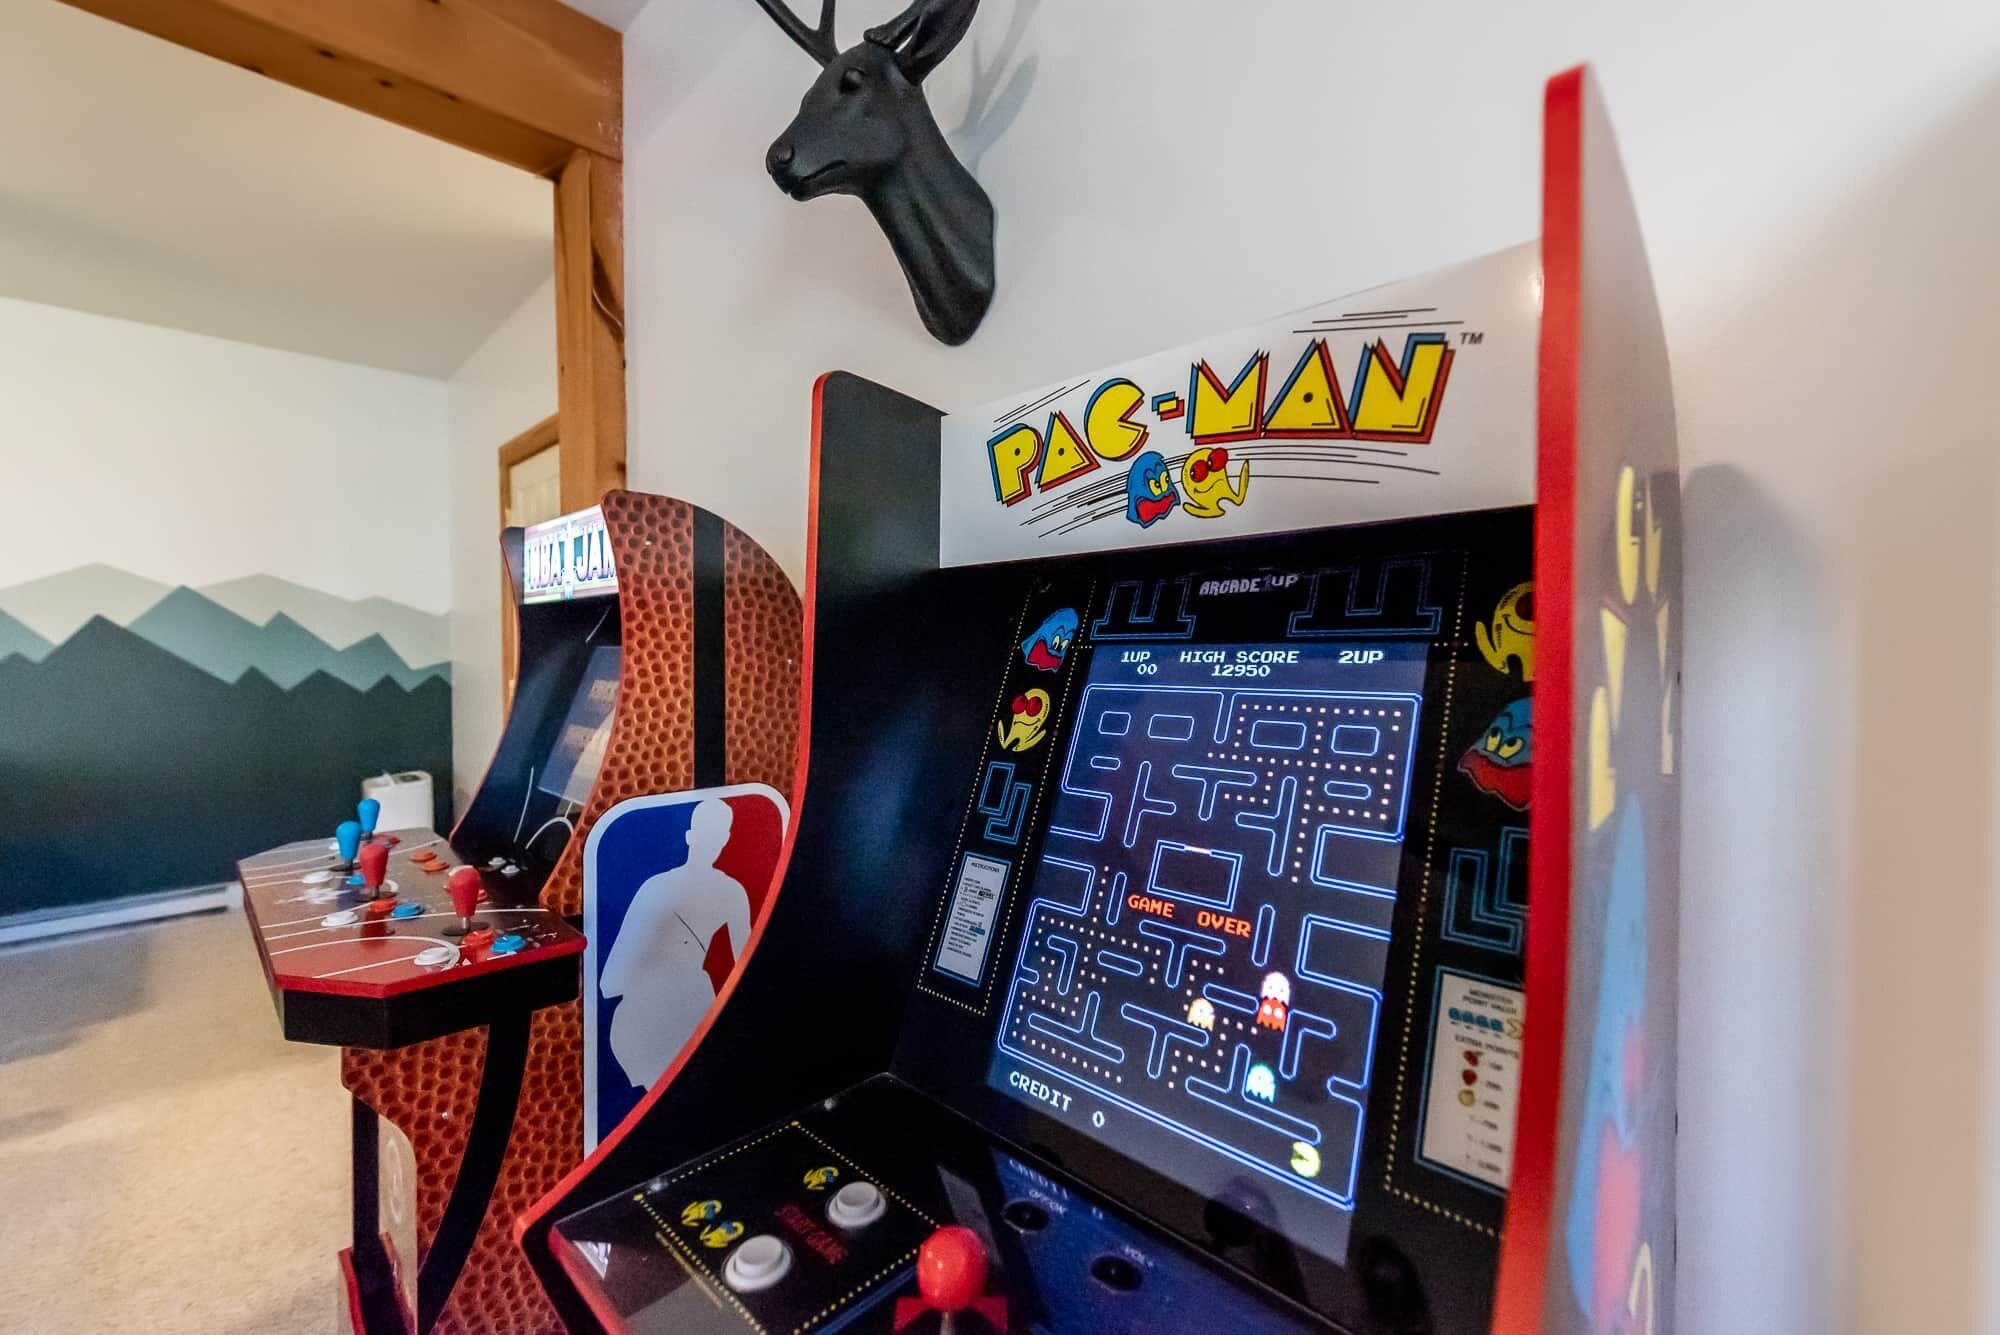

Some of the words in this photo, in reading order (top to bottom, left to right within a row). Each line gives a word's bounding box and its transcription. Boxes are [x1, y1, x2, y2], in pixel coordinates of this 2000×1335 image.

[987, 333, 1455, 506] PAC-MAN
[1460, 332, 1485, 345] TM
[1120, 651, 1151, 663] 1UP
[1180, 651, 1226, 664] HIGH
[1235, 651, 1300, 664] SCORE
[1338, 650, 1384, 665] 2UP
[1136, 663, 1158, 675] 00
[1211, 664, 1271, 677] 12950
[1127, 894, 1176, 919] GAME
[1197, 911, 1252, 939] OVER
[1009, 1070, 1073, 1113] CREDIT
[1091, 1110, 1106, 1129] 0
